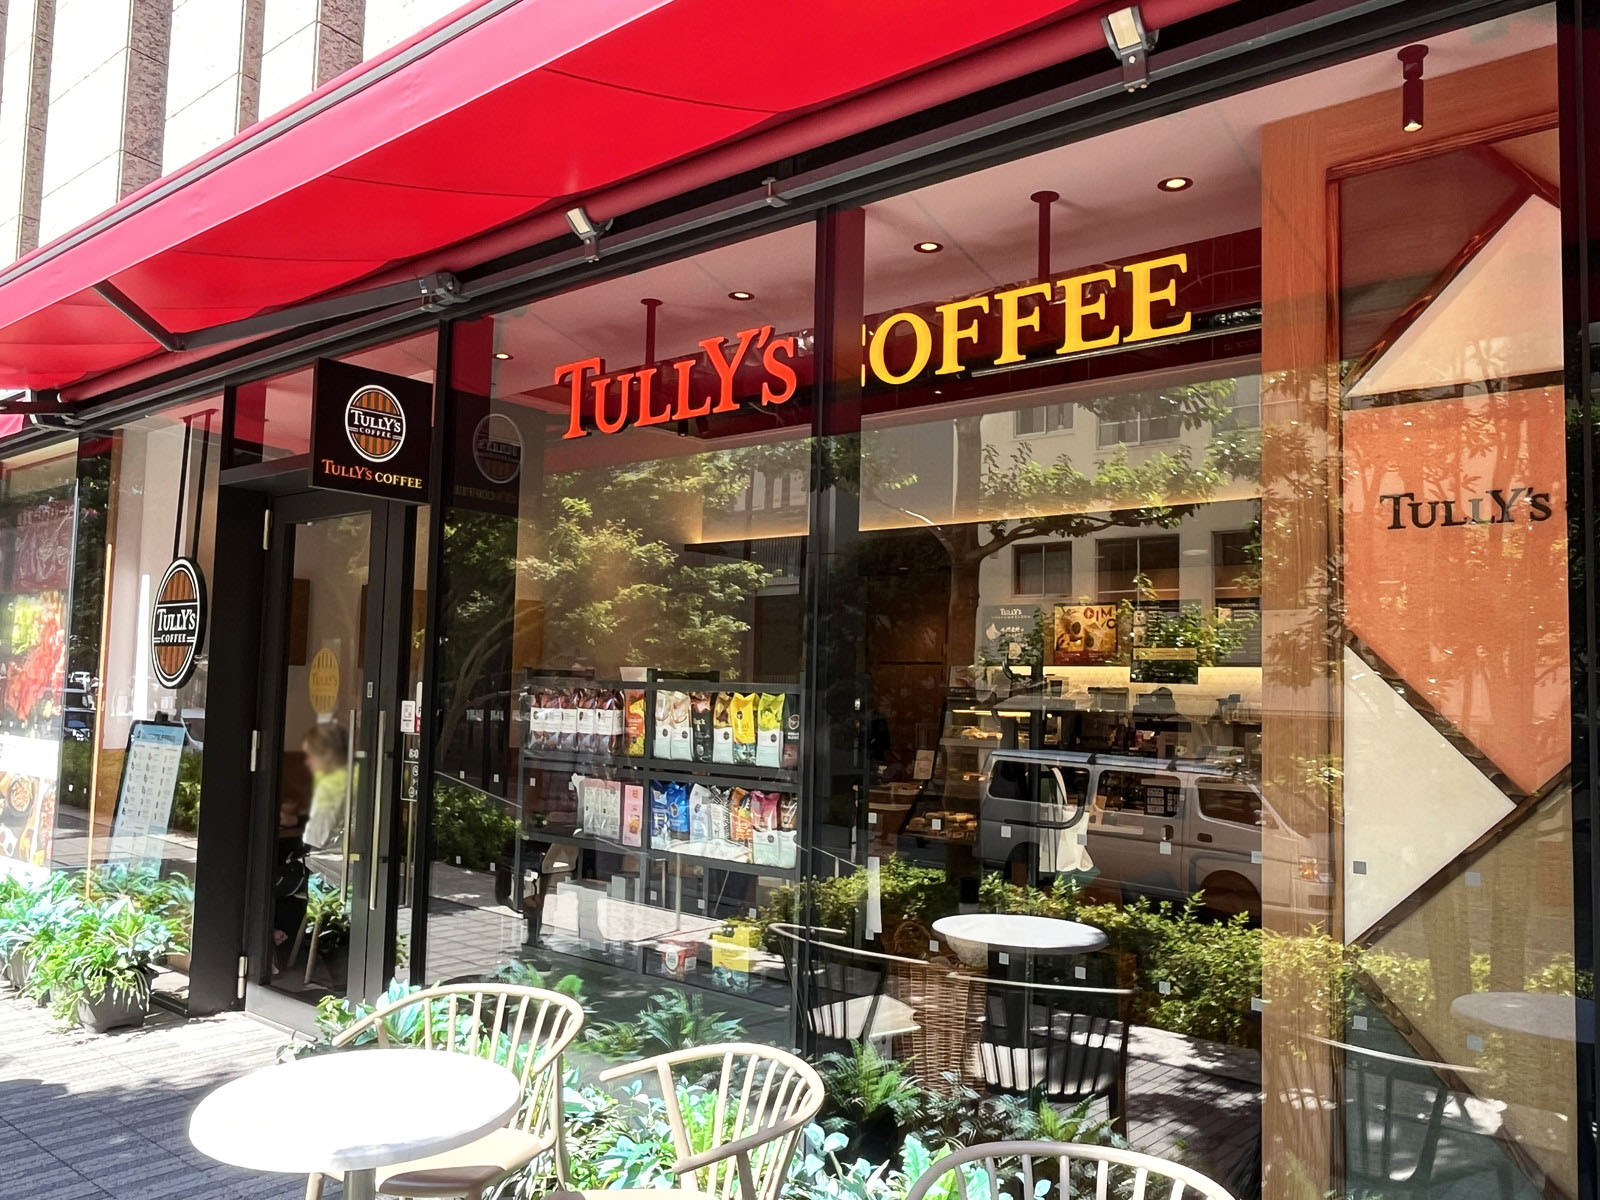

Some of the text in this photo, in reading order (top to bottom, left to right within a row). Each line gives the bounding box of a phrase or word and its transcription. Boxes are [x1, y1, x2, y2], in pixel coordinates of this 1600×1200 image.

[861, 253, 1193, 387] OFFEE
[359, 427, 392, 438] COFFEE
[375, 472, 422, 489] COFFEE
[160, 633, 187, 643] COFFEE
